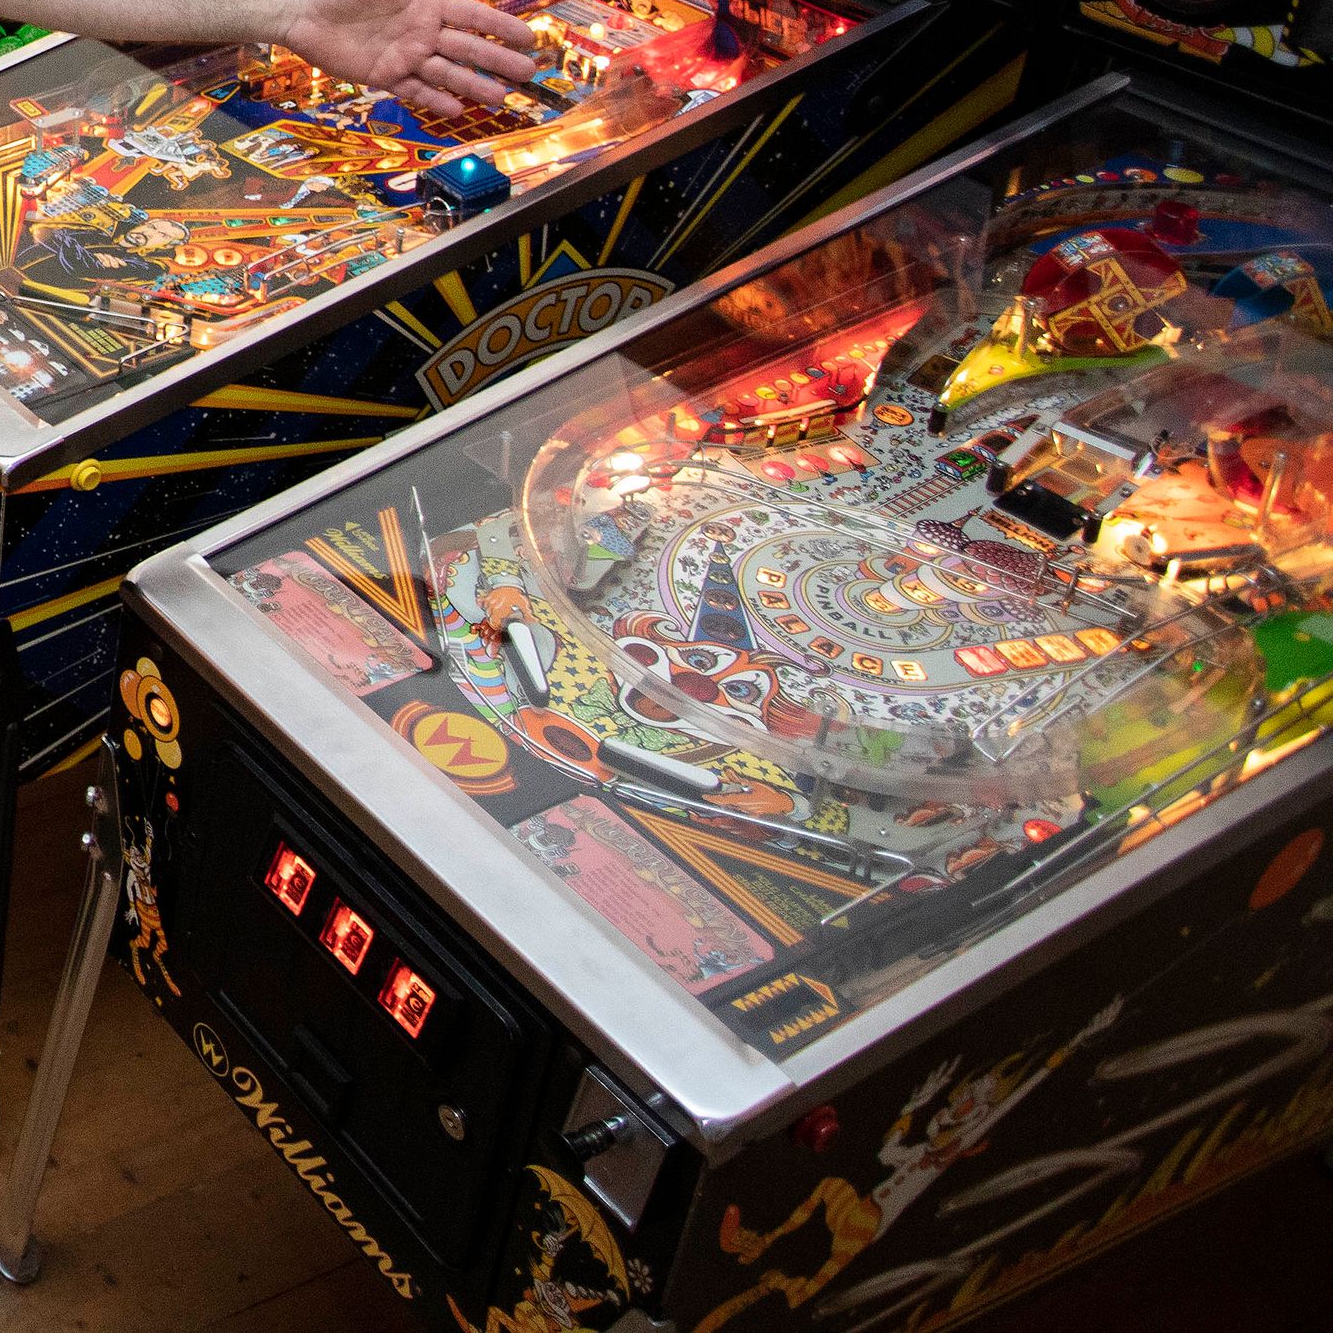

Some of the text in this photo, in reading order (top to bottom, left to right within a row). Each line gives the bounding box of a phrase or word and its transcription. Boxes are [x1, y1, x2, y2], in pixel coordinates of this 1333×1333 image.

[439, 278, 664, 400] DOCTOR
[323, 528, 390, 580] Williams
[984, 512, 1055, 553] MILLION
[820, 572, 896, 642] PINBALL
[232, 1067, 414, 1299] Williams
